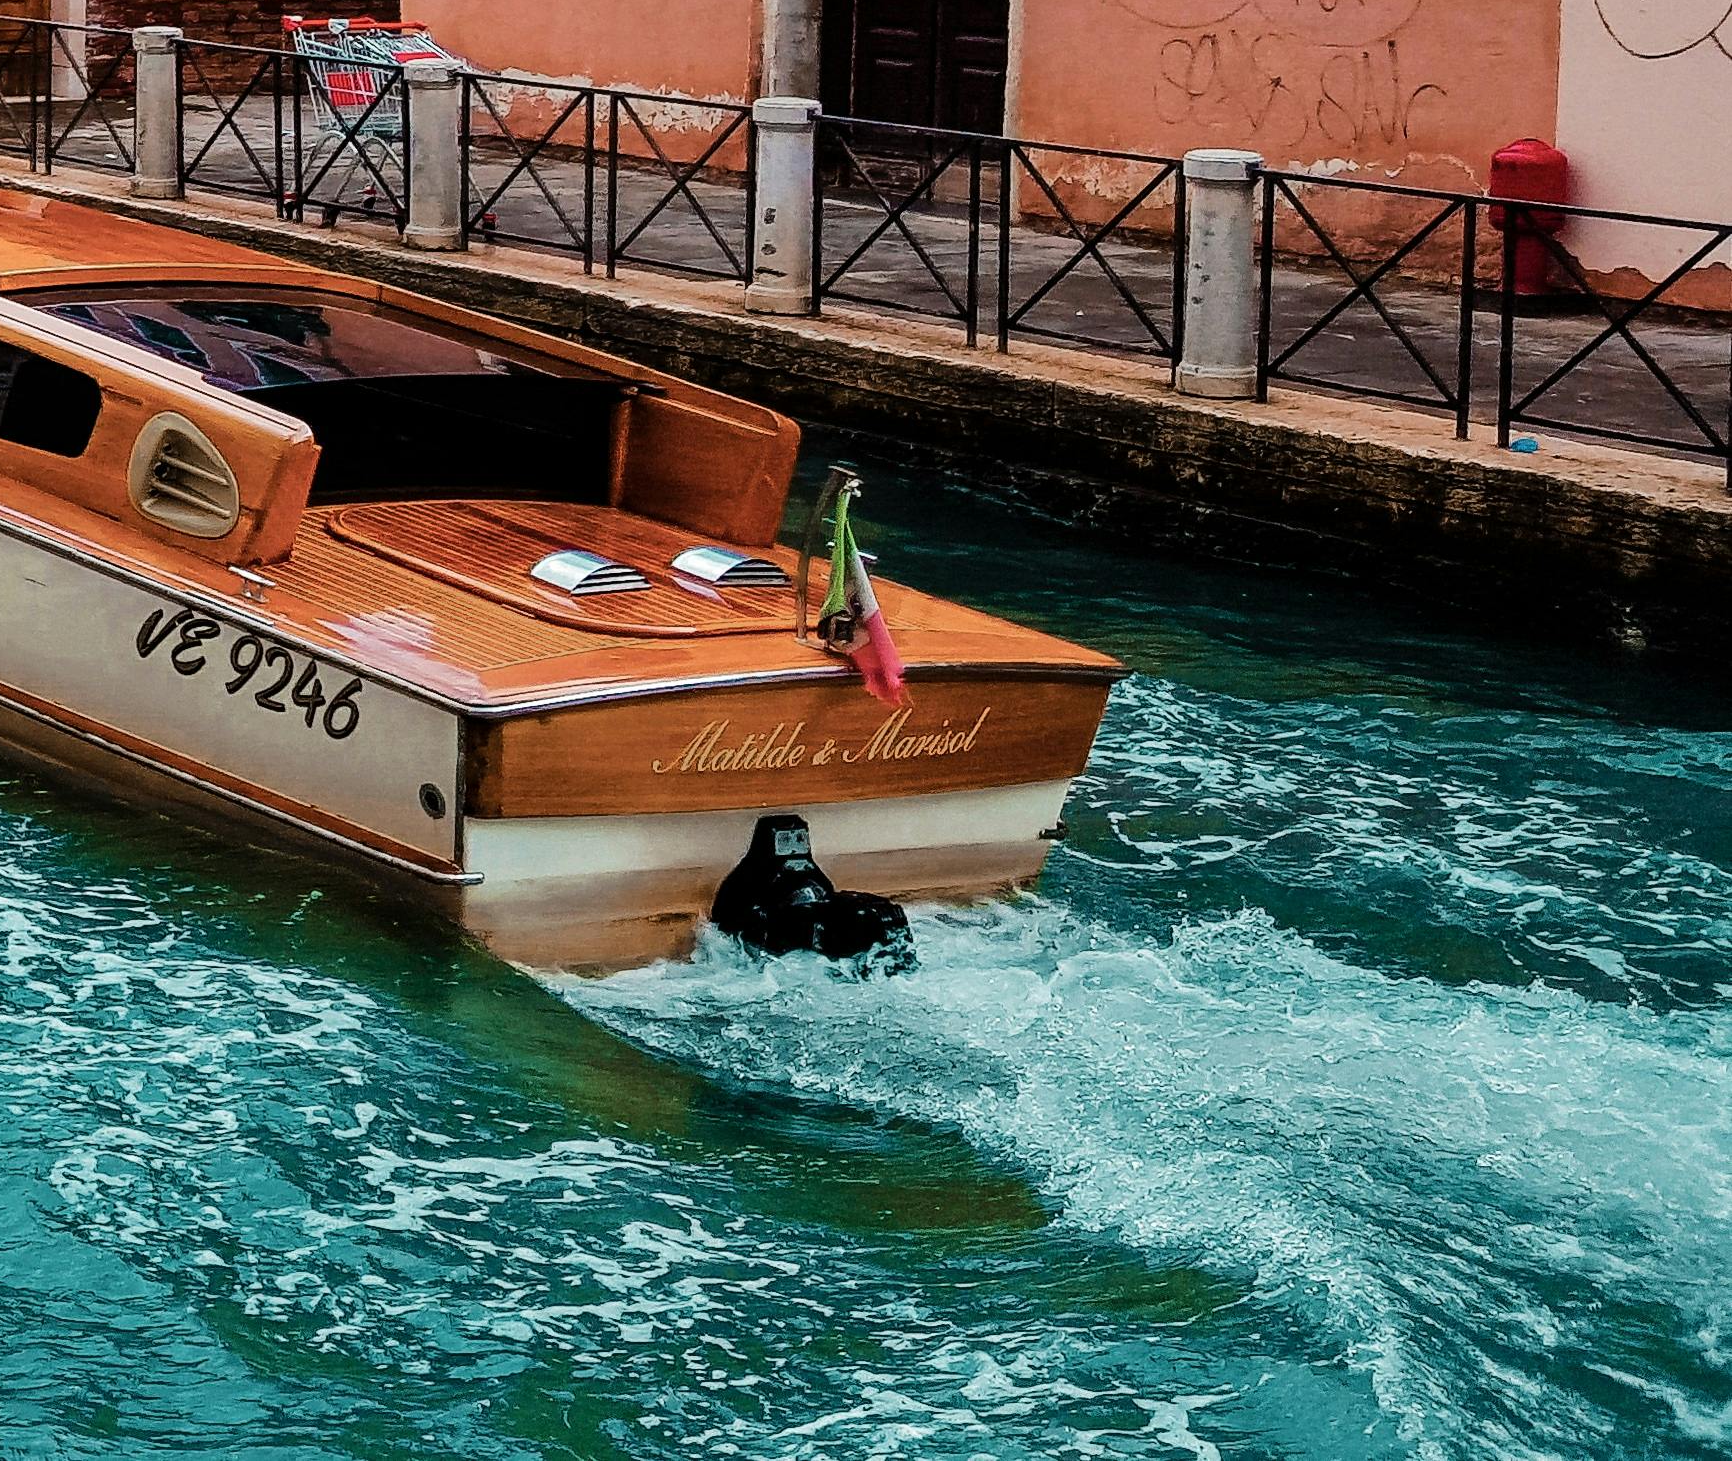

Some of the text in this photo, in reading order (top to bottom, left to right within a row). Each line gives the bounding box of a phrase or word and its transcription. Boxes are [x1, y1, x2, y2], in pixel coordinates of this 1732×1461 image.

[135, 607, 363, 740] VE 9246
[651, 706, 992, 774] Matilde & Marisol
